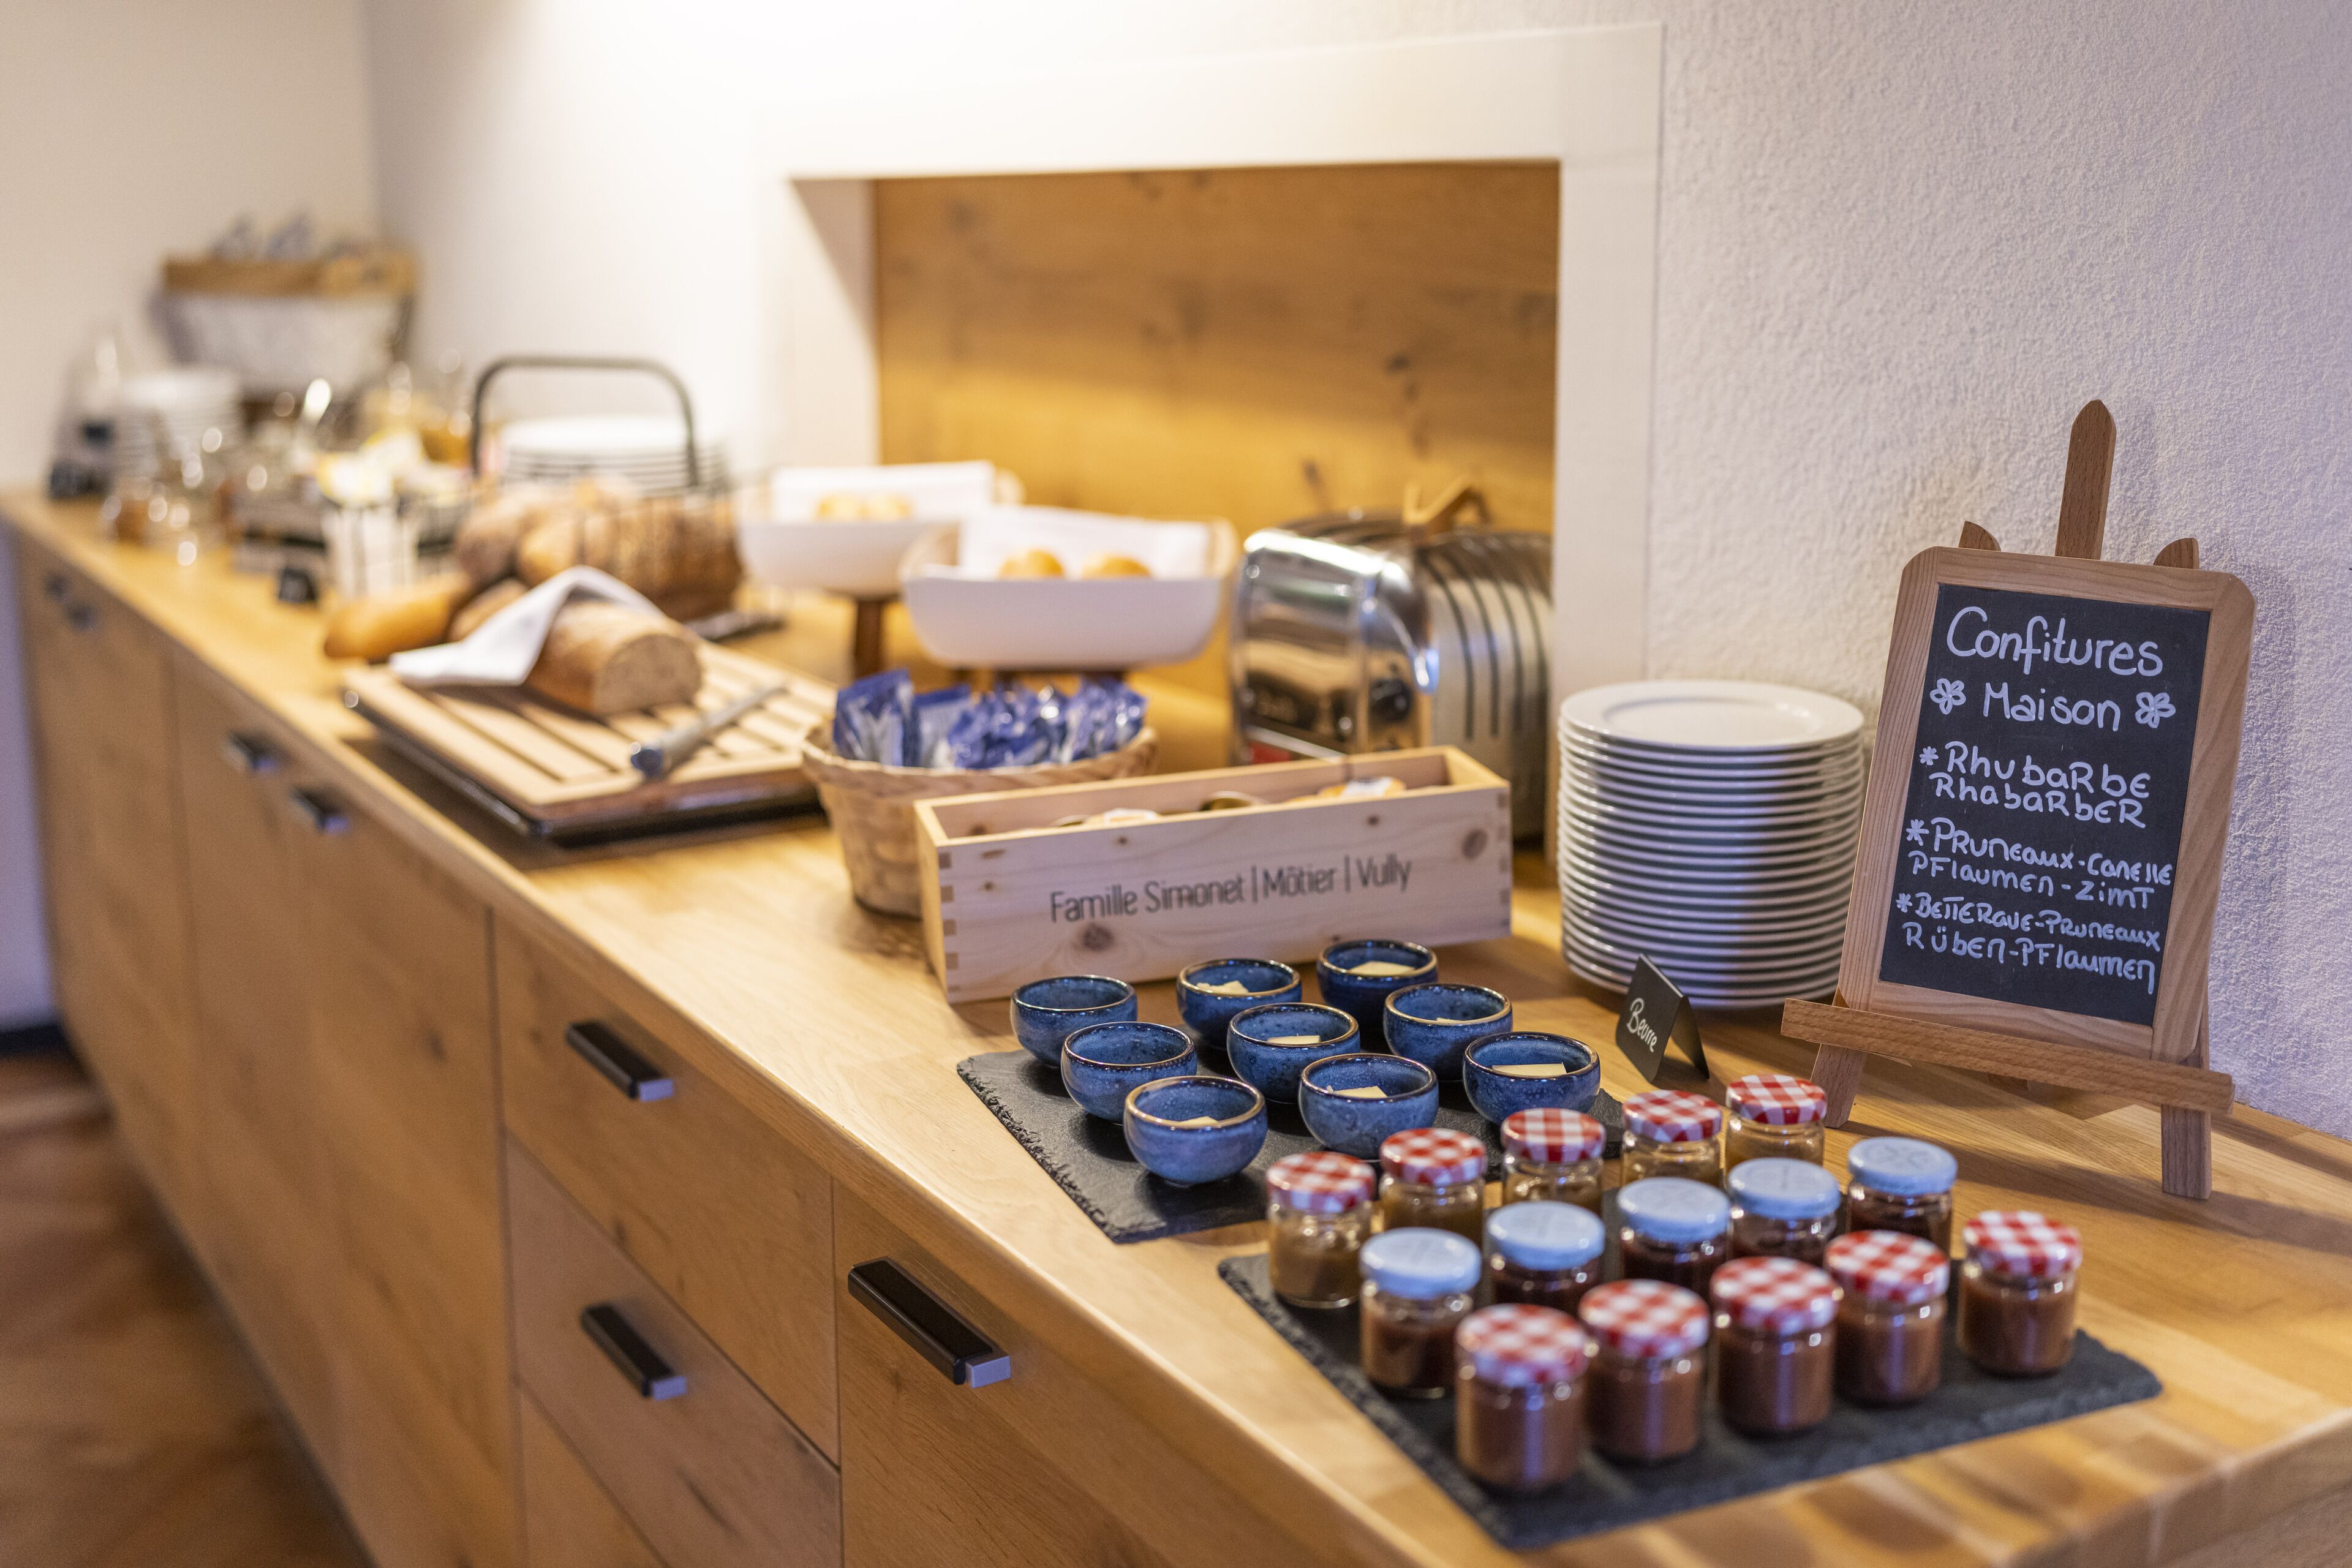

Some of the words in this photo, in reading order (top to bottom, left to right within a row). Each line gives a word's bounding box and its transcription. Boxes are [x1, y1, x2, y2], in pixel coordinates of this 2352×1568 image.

[1947, 606, 2163, 676] Confitures
[1983, 682, 2121, 731] Maison
[1050, 883, 1138, 922] Famille
[1144, 873, 1245, 913] Simonet
[1356, 853, 1412, 892] Vully
[1626, 998, 1657, 1053] Beurre
